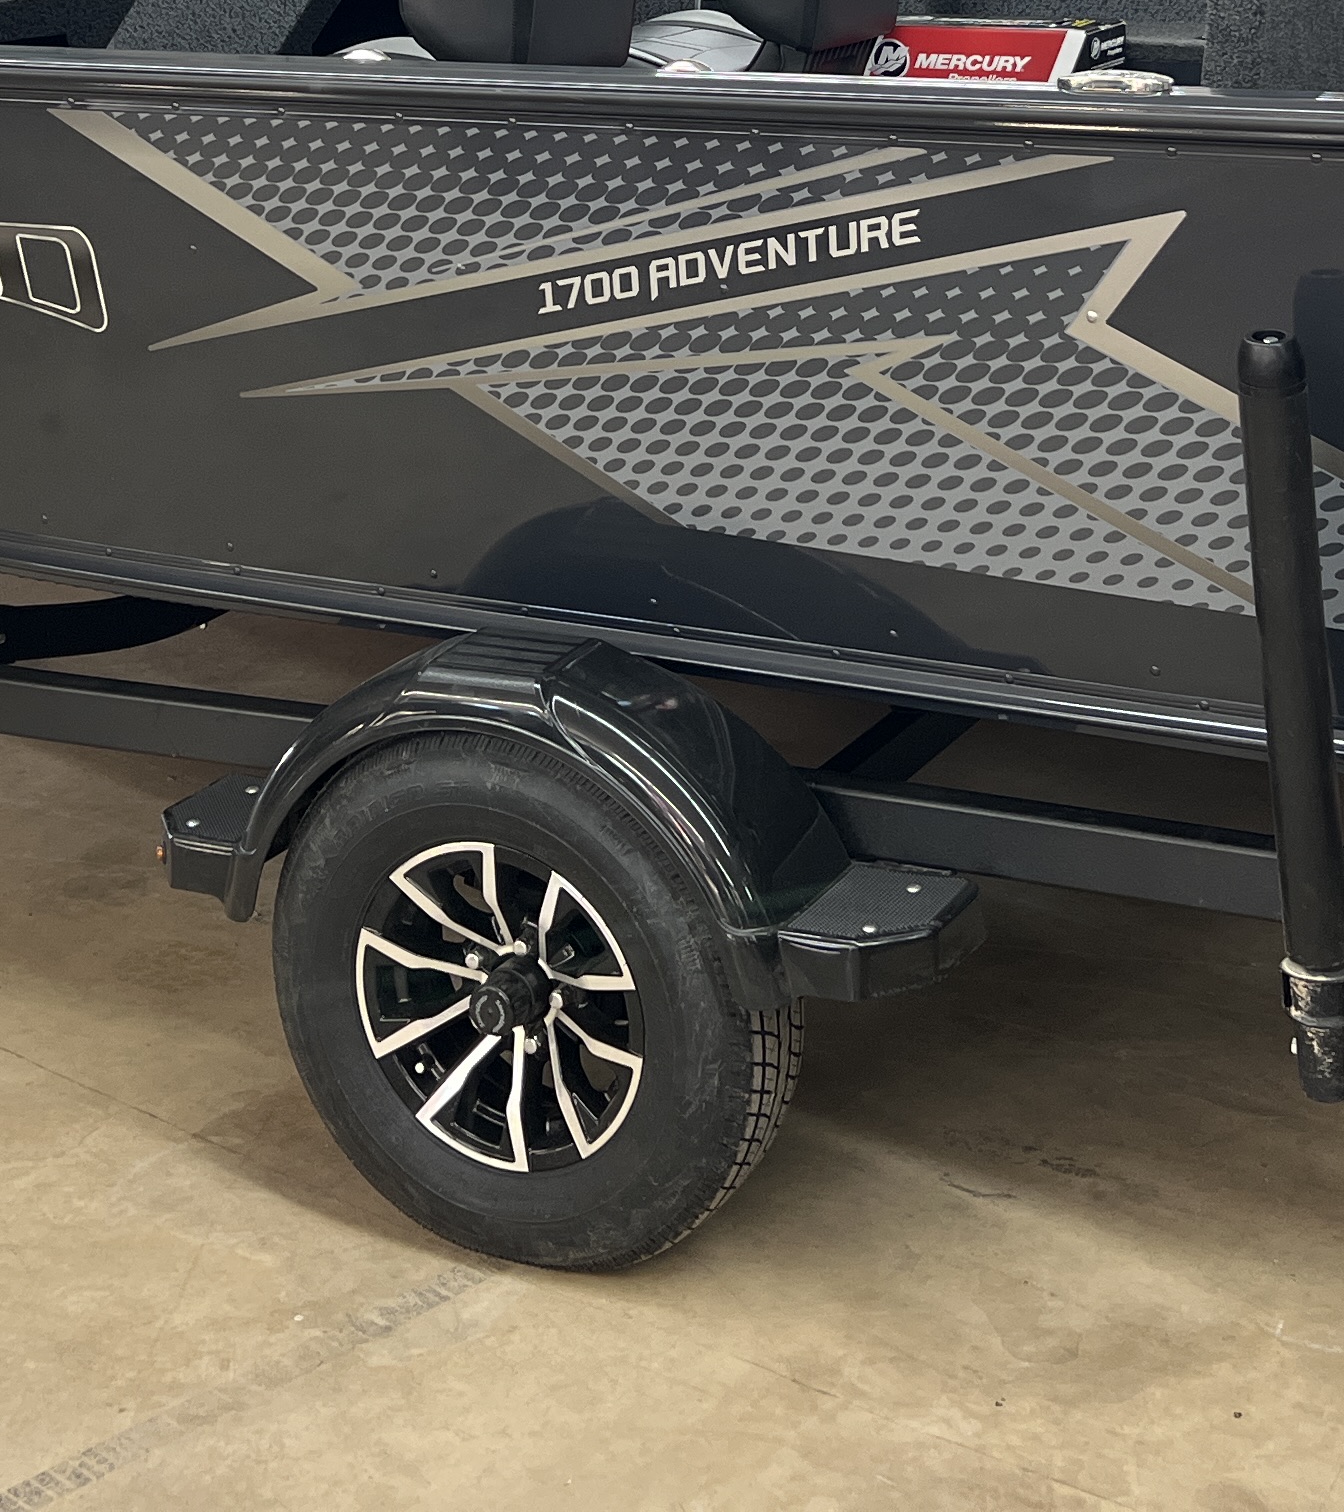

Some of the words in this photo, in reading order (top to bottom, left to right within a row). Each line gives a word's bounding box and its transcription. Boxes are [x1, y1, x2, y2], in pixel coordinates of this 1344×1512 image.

[914, 53, 1032, 72] MERCURY
[538, 265, 639, 315] 1700
[649, 208, 921, 301] ADVENTURE
